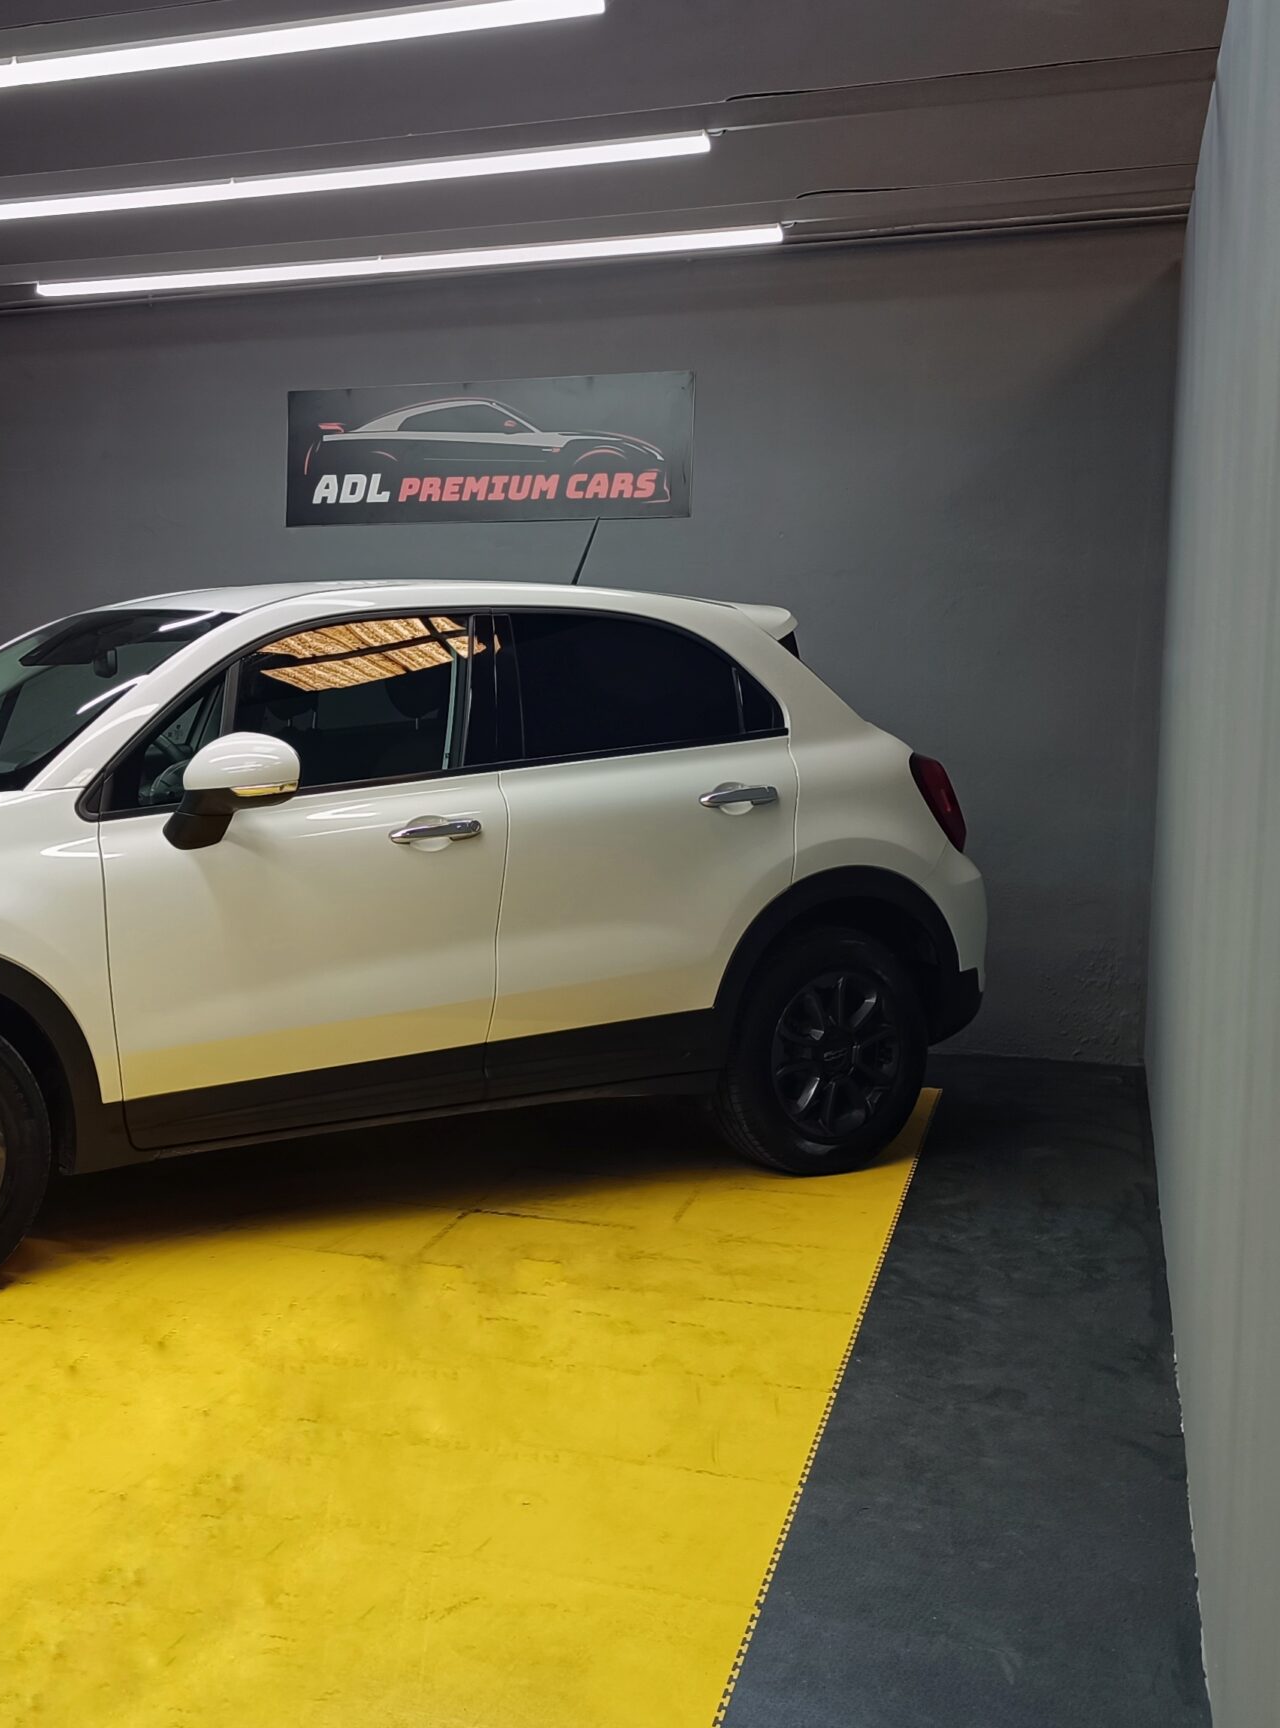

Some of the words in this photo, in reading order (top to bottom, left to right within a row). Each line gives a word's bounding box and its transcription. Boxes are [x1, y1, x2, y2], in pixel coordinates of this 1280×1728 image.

[312, 474, 390, 504] ADL
[398, 474, 559, 502] PREMIUM
[566, 472, 657, 499] CARS
